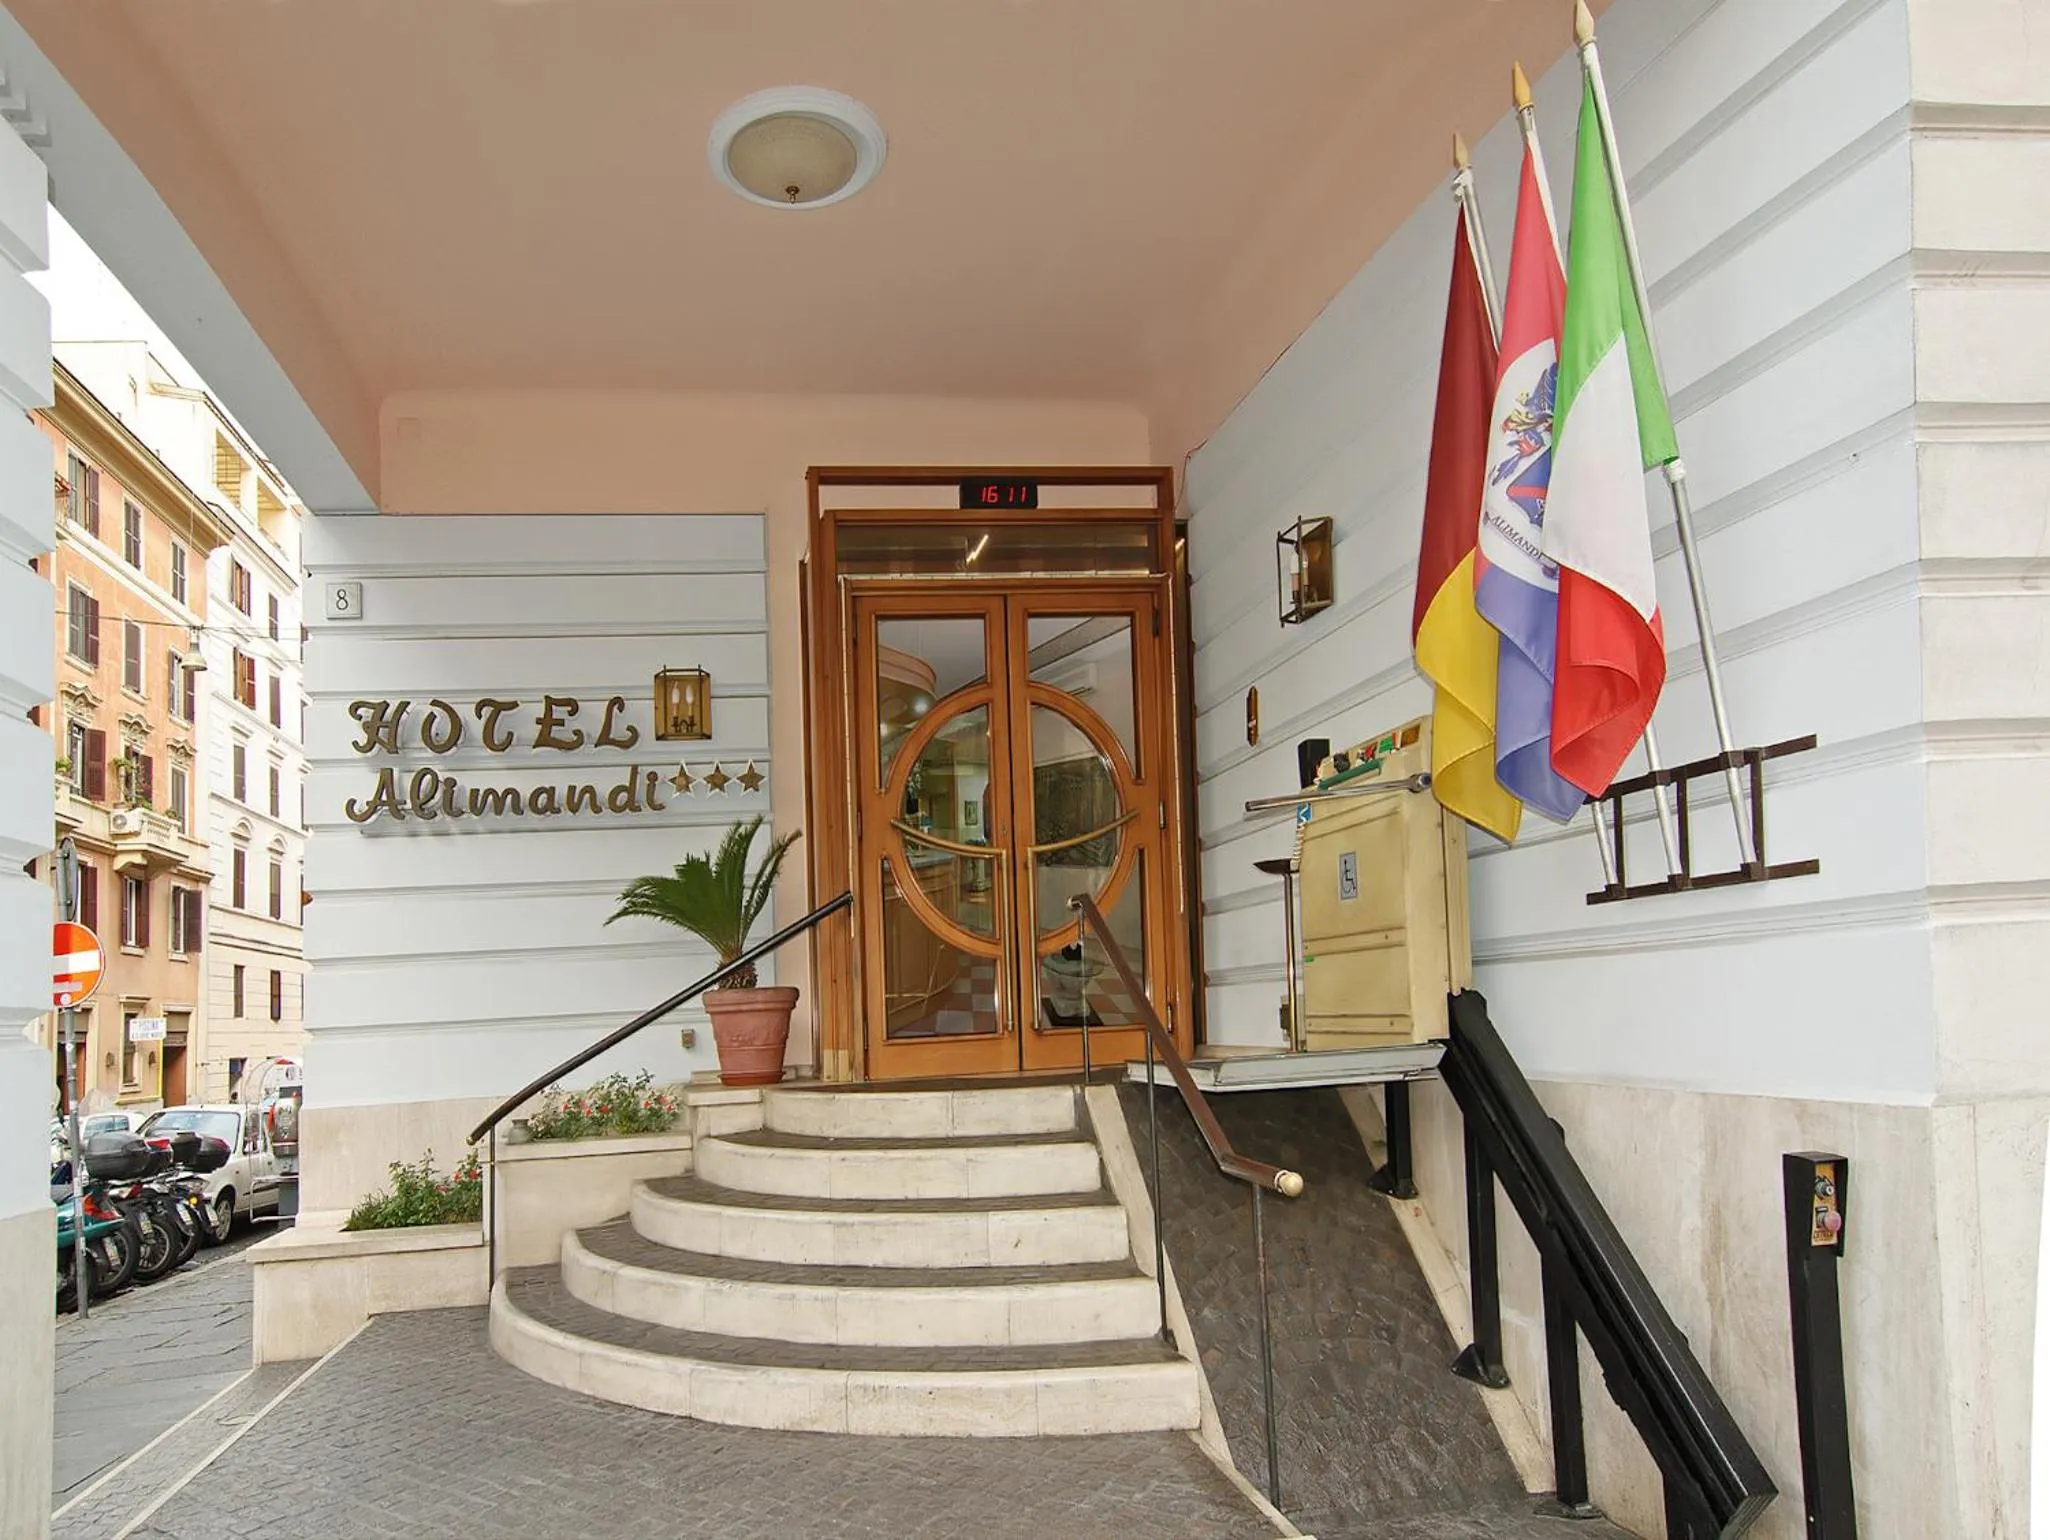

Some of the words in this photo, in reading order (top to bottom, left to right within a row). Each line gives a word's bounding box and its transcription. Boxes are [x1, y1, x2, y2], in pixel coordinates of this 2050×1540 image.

[335, 588, 349, 611] 8
[348, 695, 640, 756] HOTEL
[345, 763, 667, 824] Alimandi
